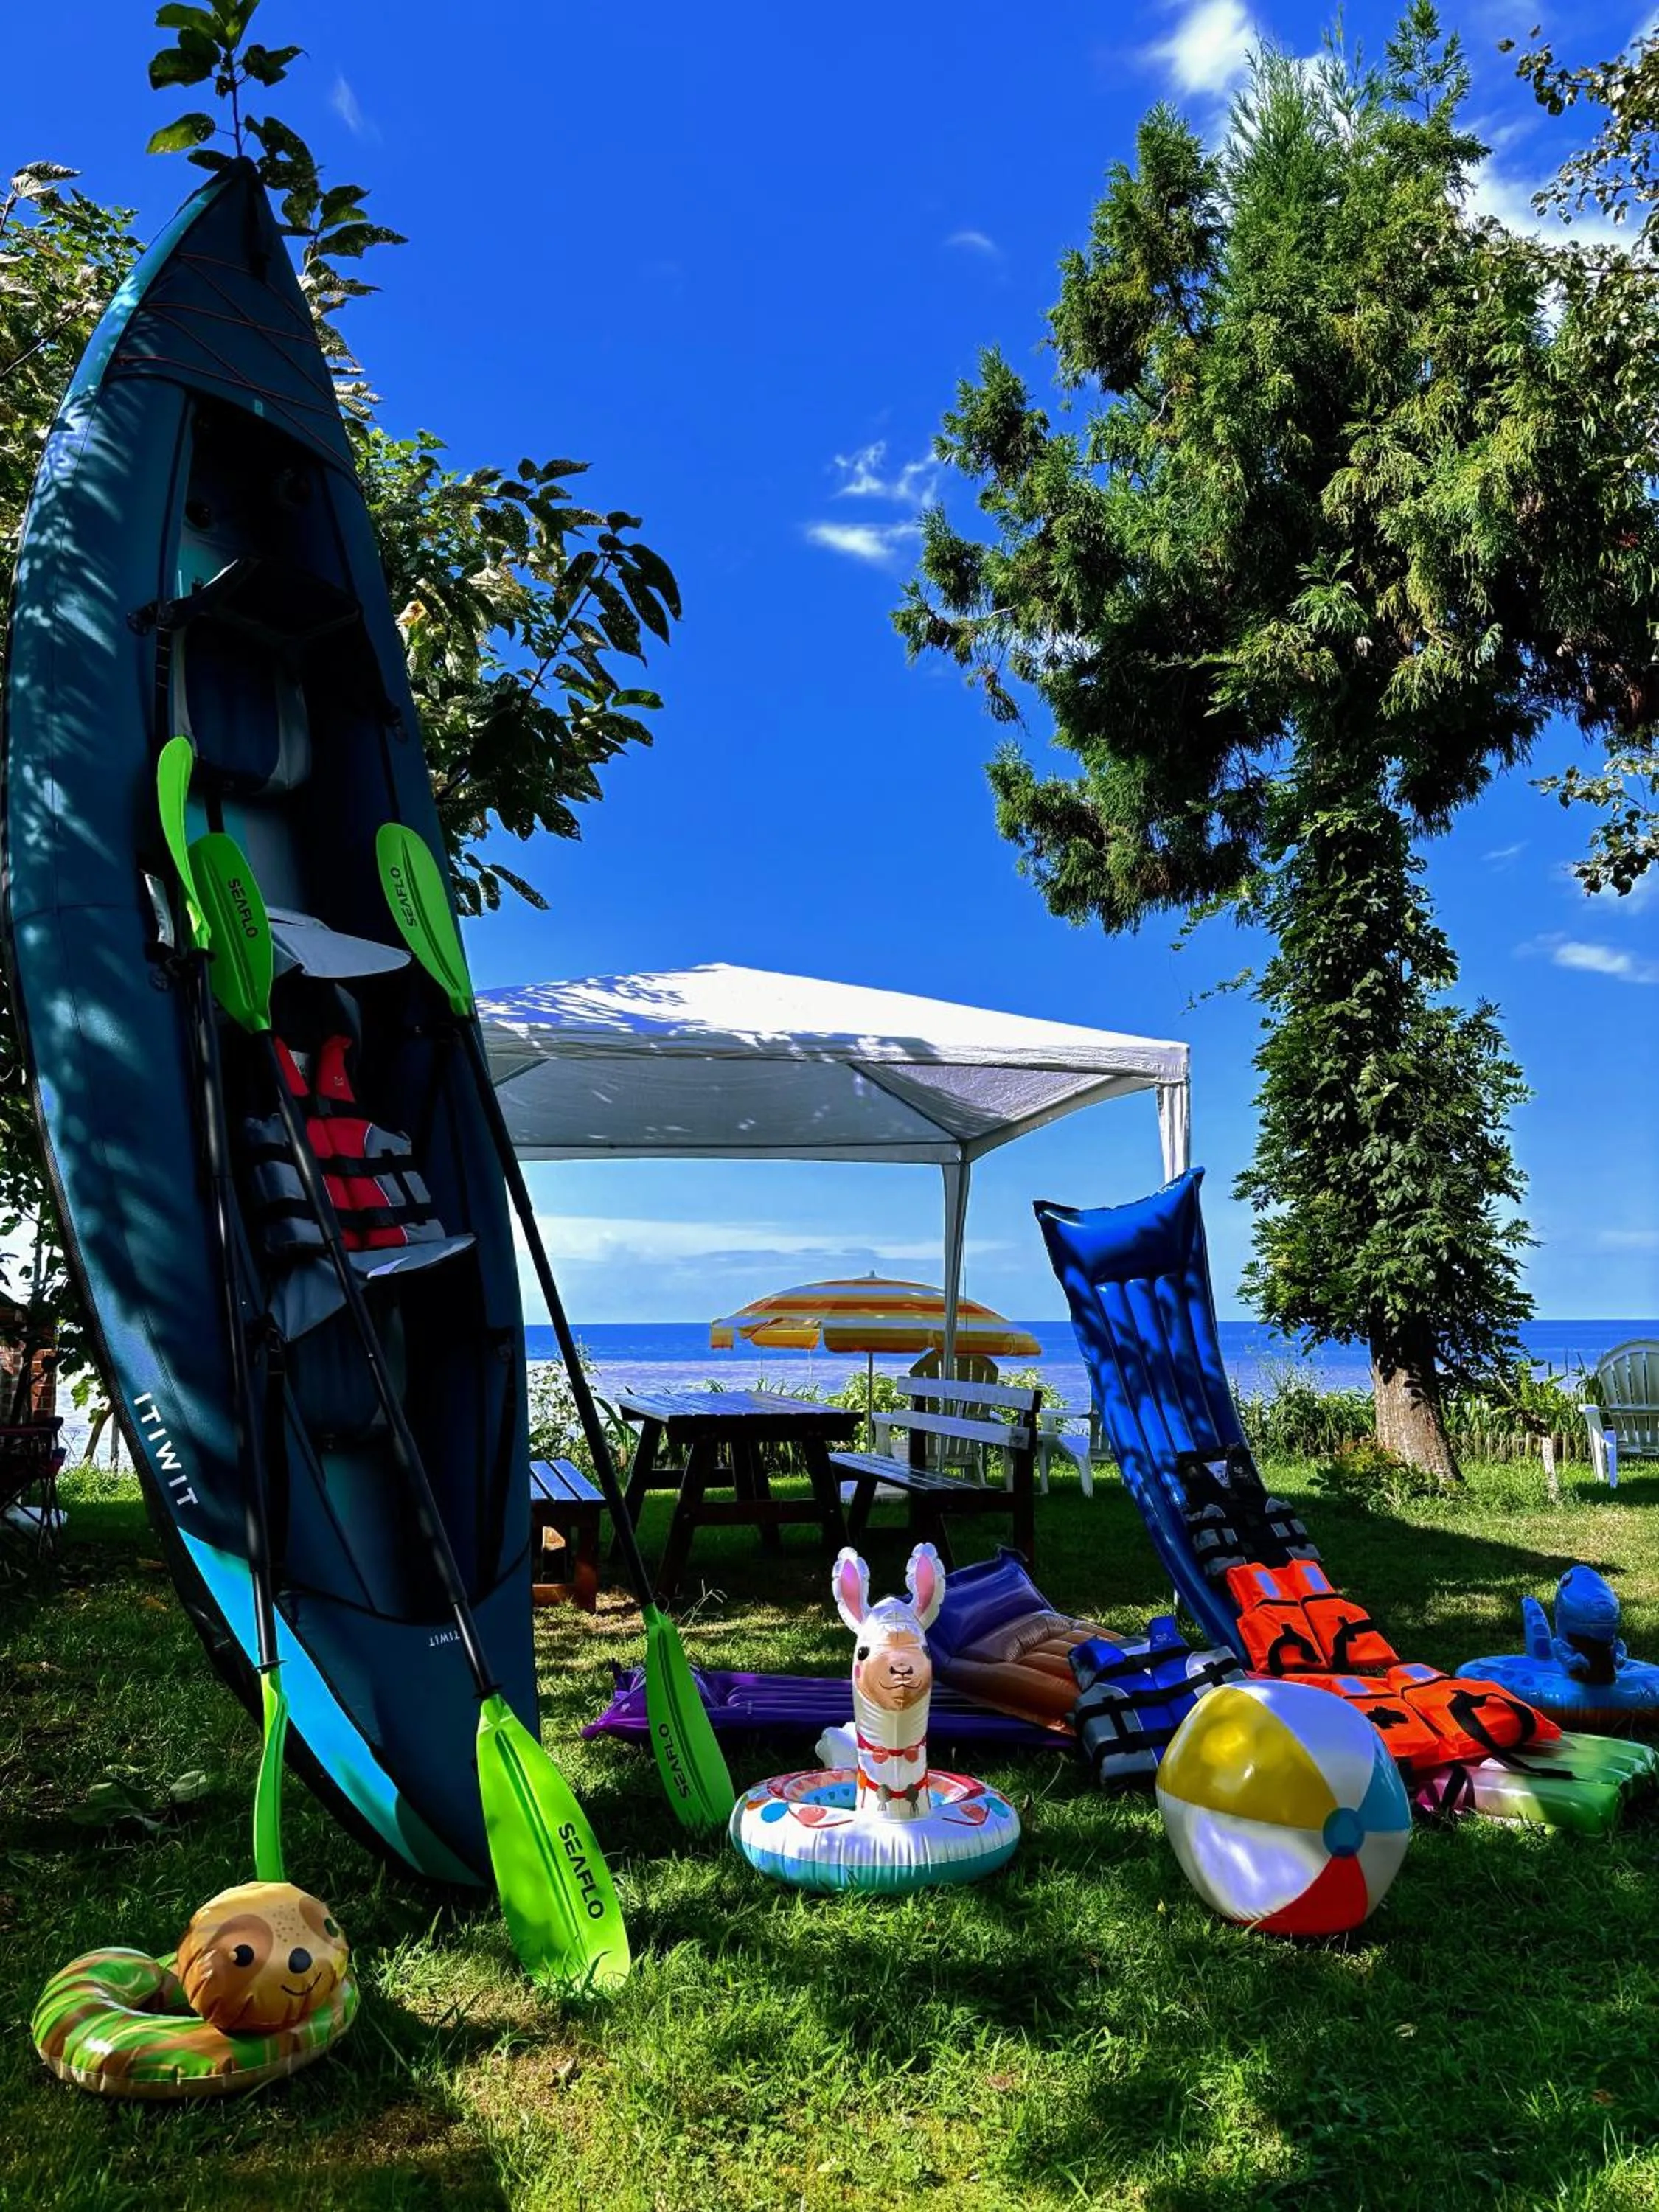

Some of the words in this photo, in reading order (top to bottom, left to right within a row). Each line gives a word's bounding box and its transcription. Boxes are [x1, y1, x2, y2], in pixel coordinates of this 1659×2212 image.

[228, 878, 258, 938] SEAFLO
[391, 867, 417, 926] SEAFLO
[133, 1392, 198, 1505] ITIWIT
[430, 1630, 460, 1646] TIWIT
[659, 1723, 690, 1798] SEAFLO
[558, 1822, 604, 1919] SEAFLO
